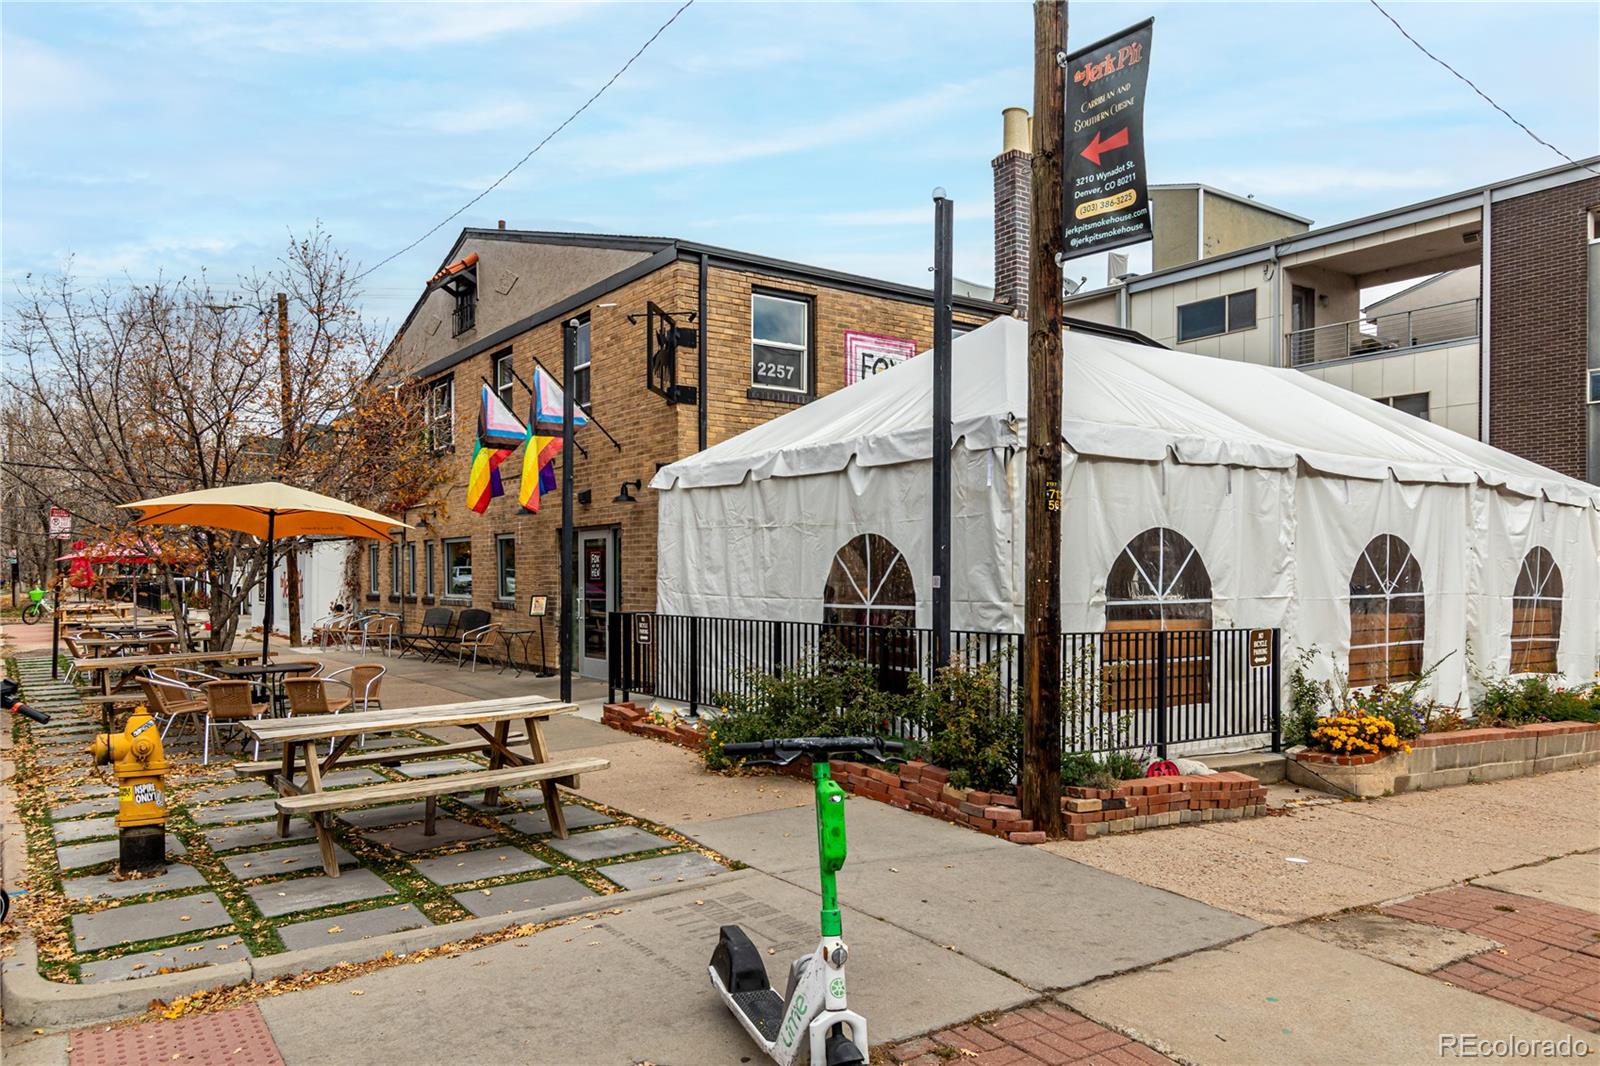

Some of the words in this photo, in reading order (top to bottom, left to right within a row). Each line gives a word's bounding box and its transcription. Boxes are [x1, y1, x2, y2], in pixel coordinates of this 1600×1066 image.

[1083, 53, 1117, 87] Jerk
[1116, 42, 1143, 71] Pit
[1074, 187, 1103, 199] Denver,
[1104, 181, 1116, 191] CO
[1116, 172, 1136, 187] 80211
[1075, 174, 1095, 187] 3210
[1096, 164, 1126, 182] Wynadot
[1126, 160, 1135, 170] St.
[1079, 202, 1098, 216] (303)
[1099, 192, 1133, 209] 386-3225
[1065, 207, 1148, 238] jerkpitsmokehouse.com
[1070, 222, 1144, 247] @jerkpitsmokehouse
[757, 362, 795, 380] 2257
[861, 352, 903, 380] FO
